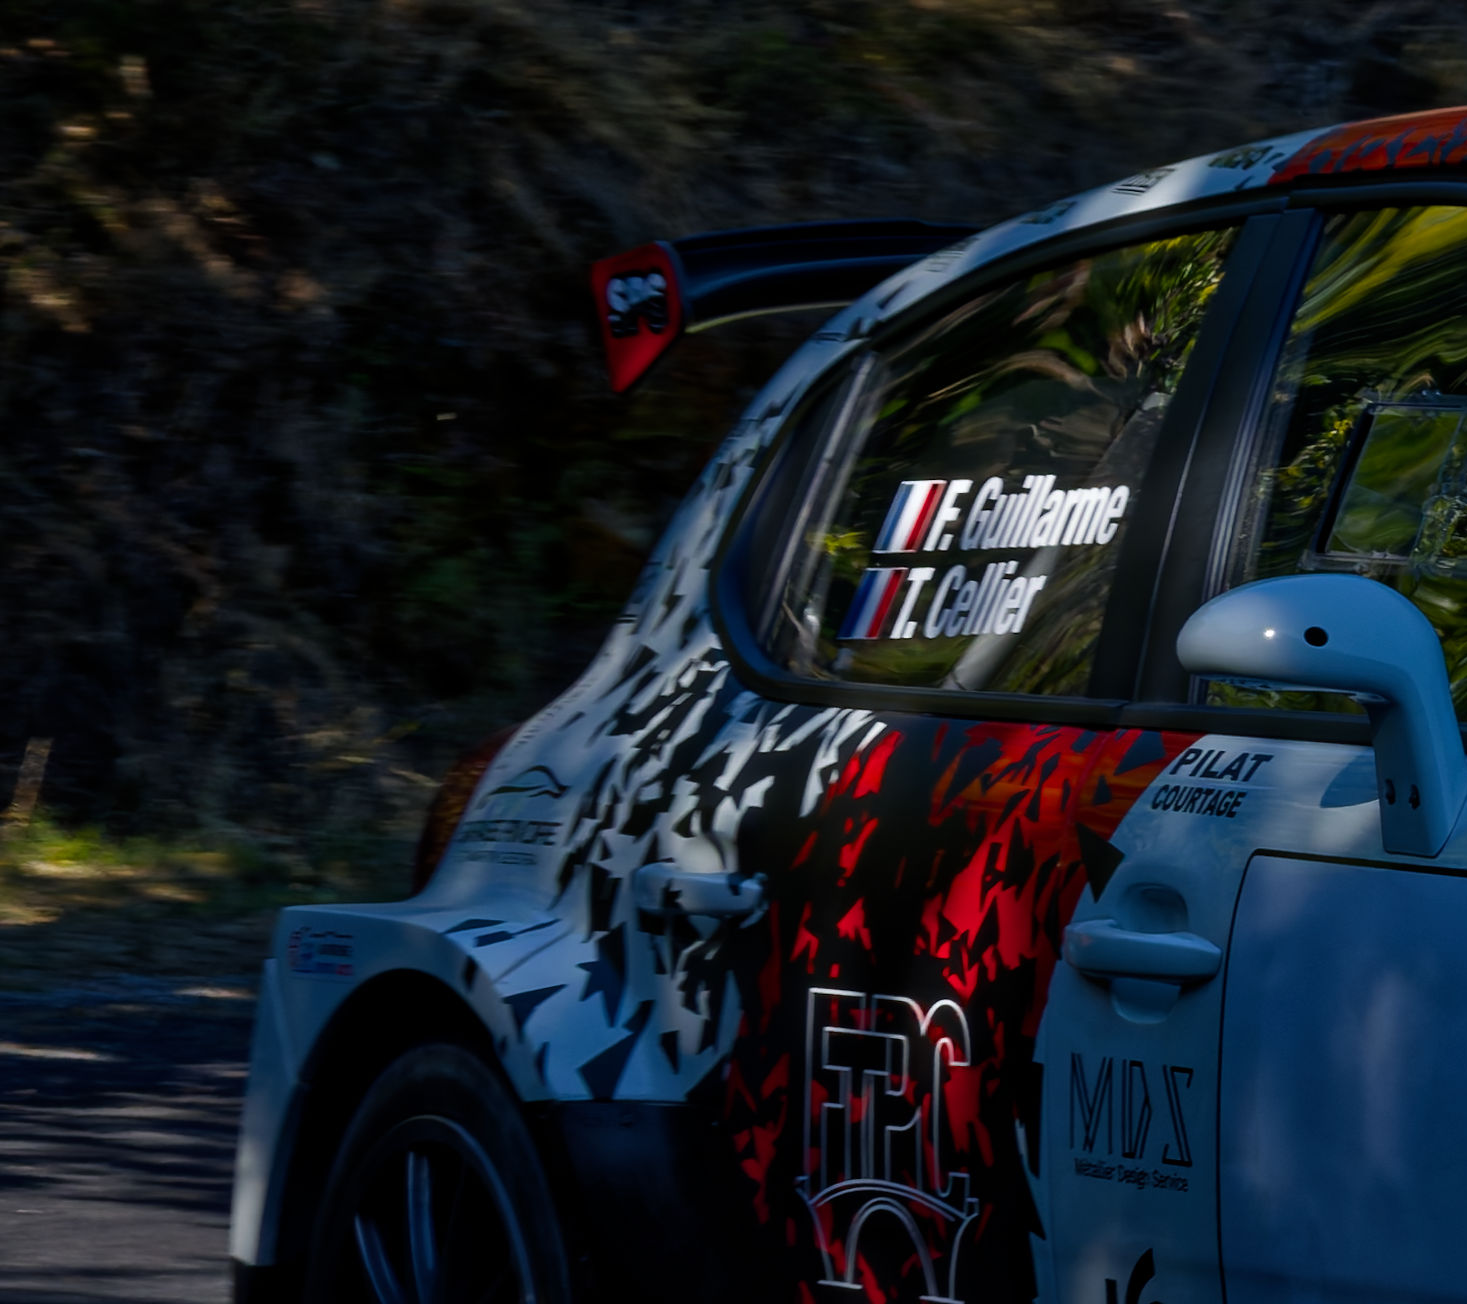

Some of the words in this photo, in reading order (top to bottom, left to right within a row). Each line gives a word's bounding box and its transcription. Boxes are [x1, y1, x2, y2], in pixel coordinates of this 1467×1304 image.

[924, 479, 975, 552] F.
[959, 475, 1131, 550] Guillarme
[891, 569, 937, 640] T.
[925, 560, 1047, 639] Cellier
[1169, 748, 1274, 783] PILAT
[1151, 784, 1248, 818] COURTAGE
